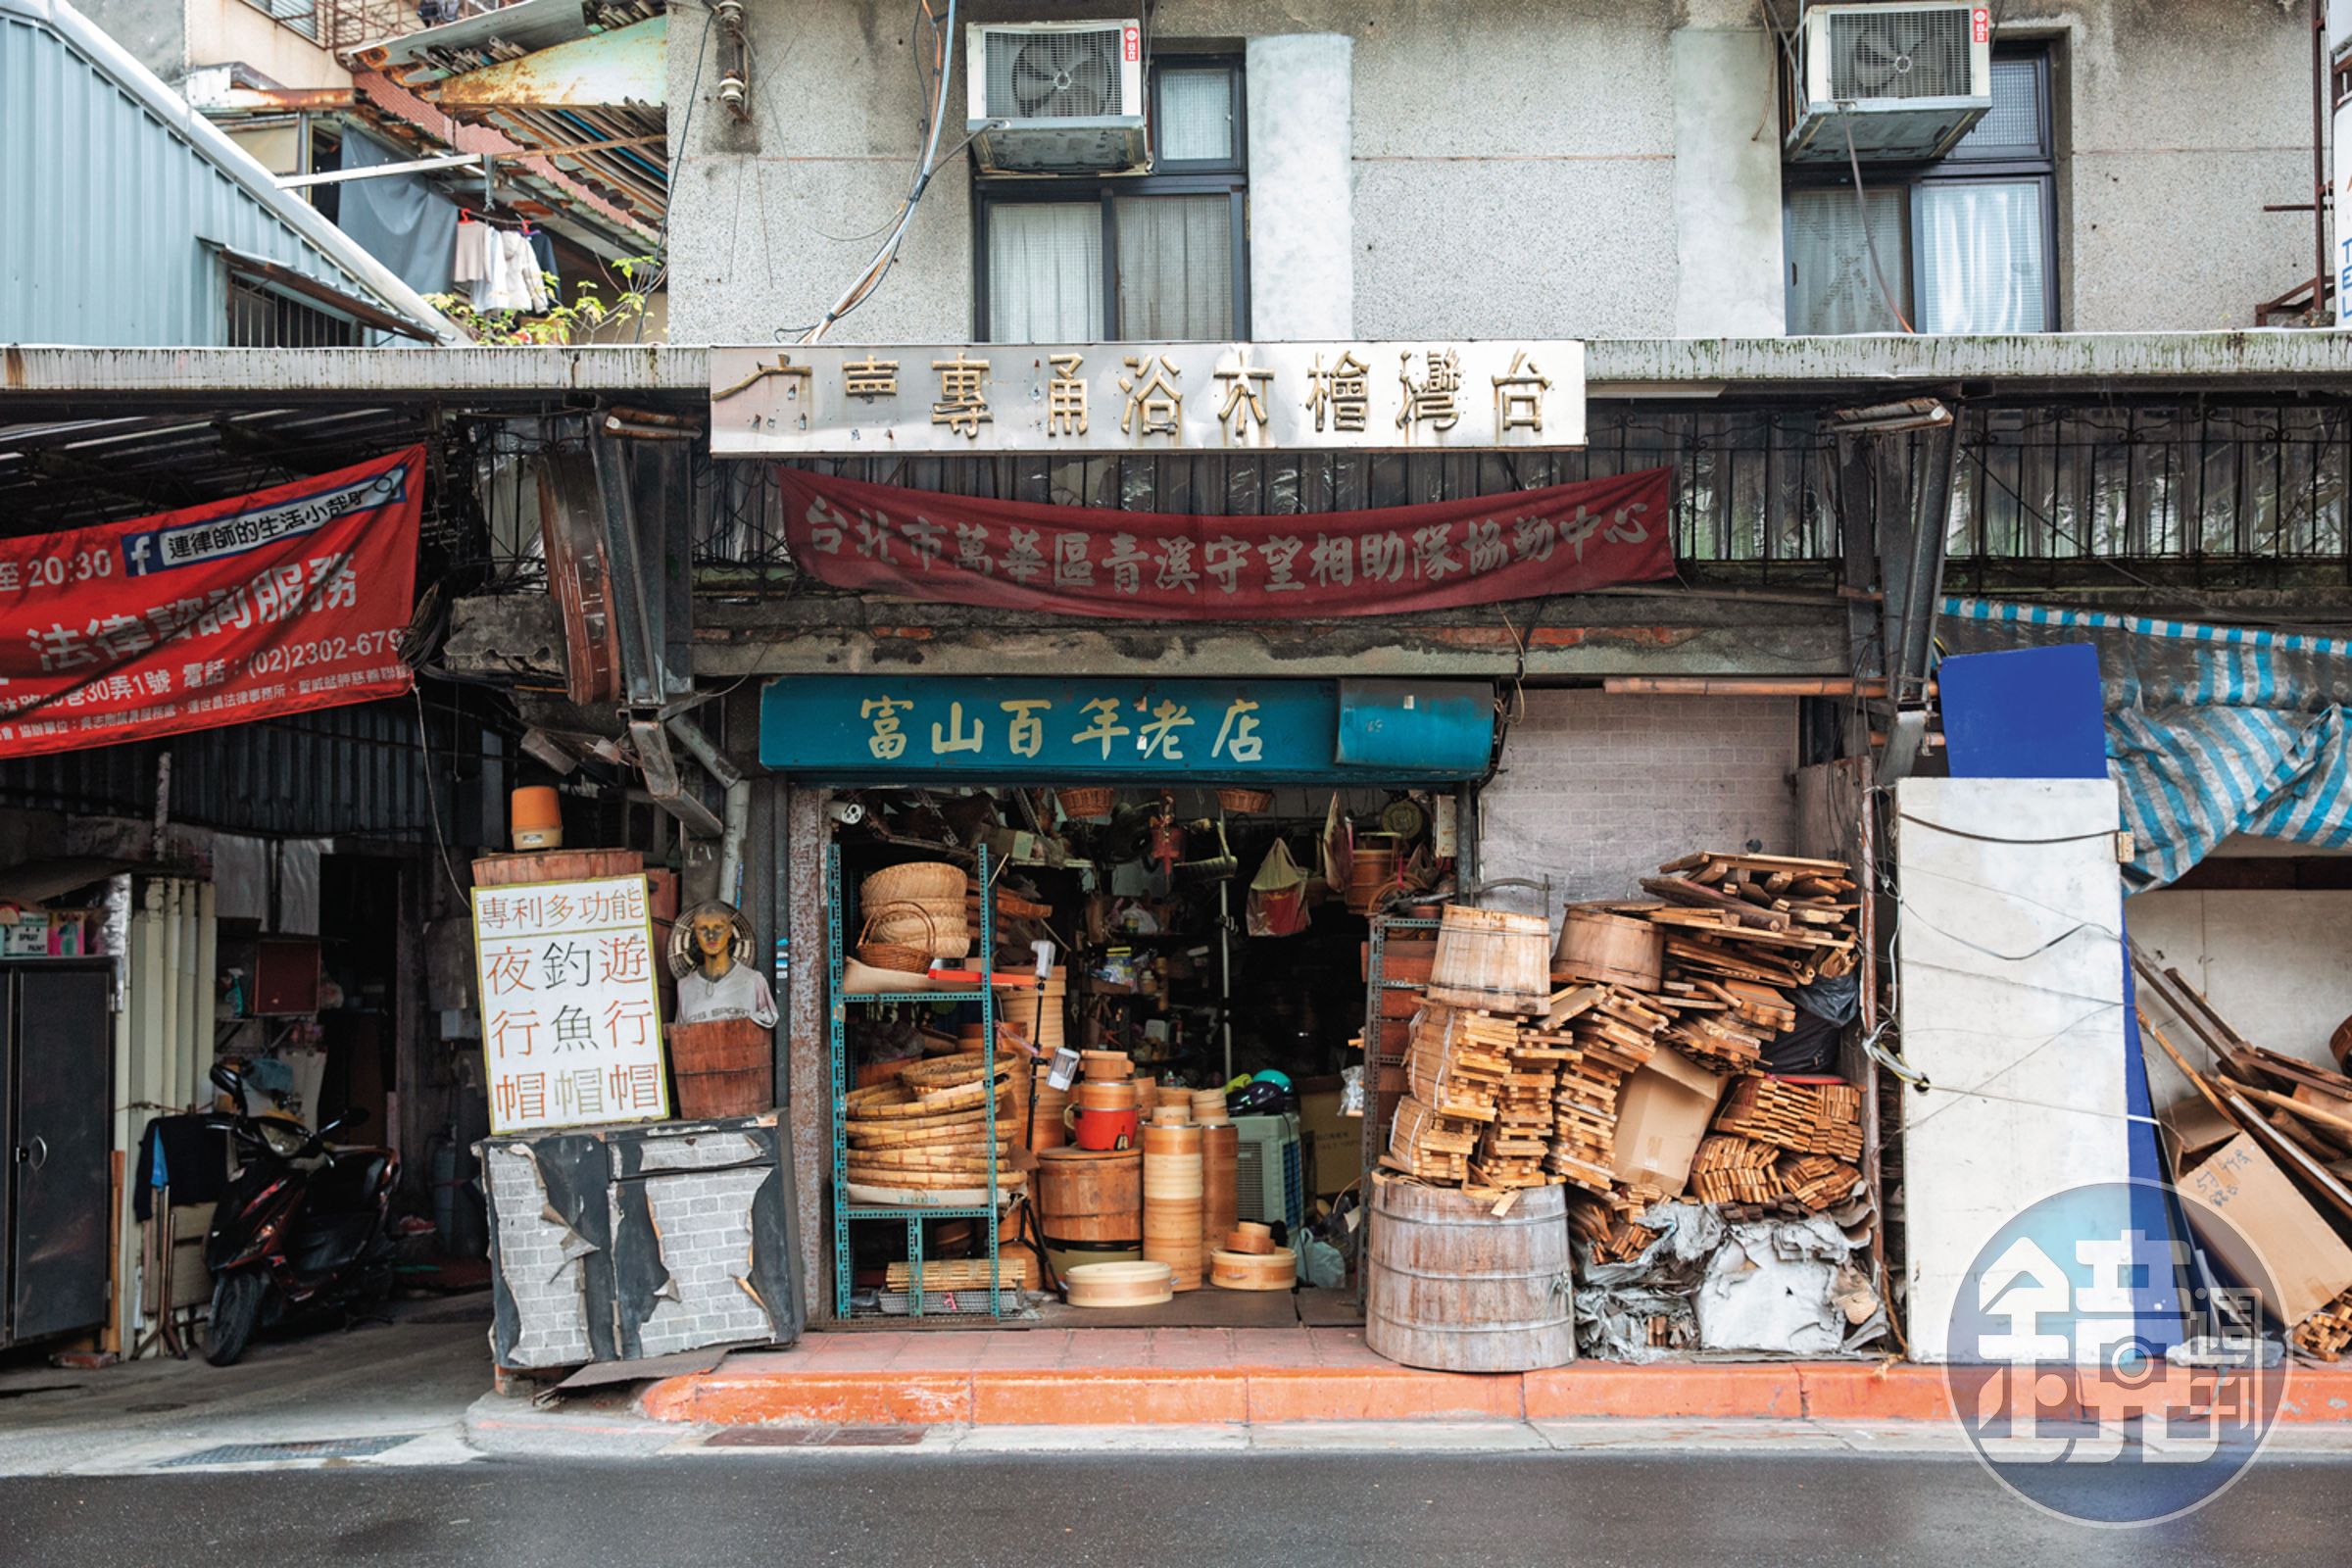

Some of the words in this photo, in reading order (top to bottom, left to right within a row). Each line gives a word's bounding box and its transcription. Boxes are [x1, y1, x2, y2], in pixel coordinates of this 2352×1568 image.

[26, 552, 358, 671] 法律諮詢服務
[27, 549, 112, 587] 20:30
[859, 694, 1263, 762] 富山百年老店
[478, 886, 645, 930] 專利多功能
[484, 945, 546, 1121] 夜行帽
[541, 941, 604, 1117] 釣魚帽
[598, 936, 660, 1111] 遊行帽
